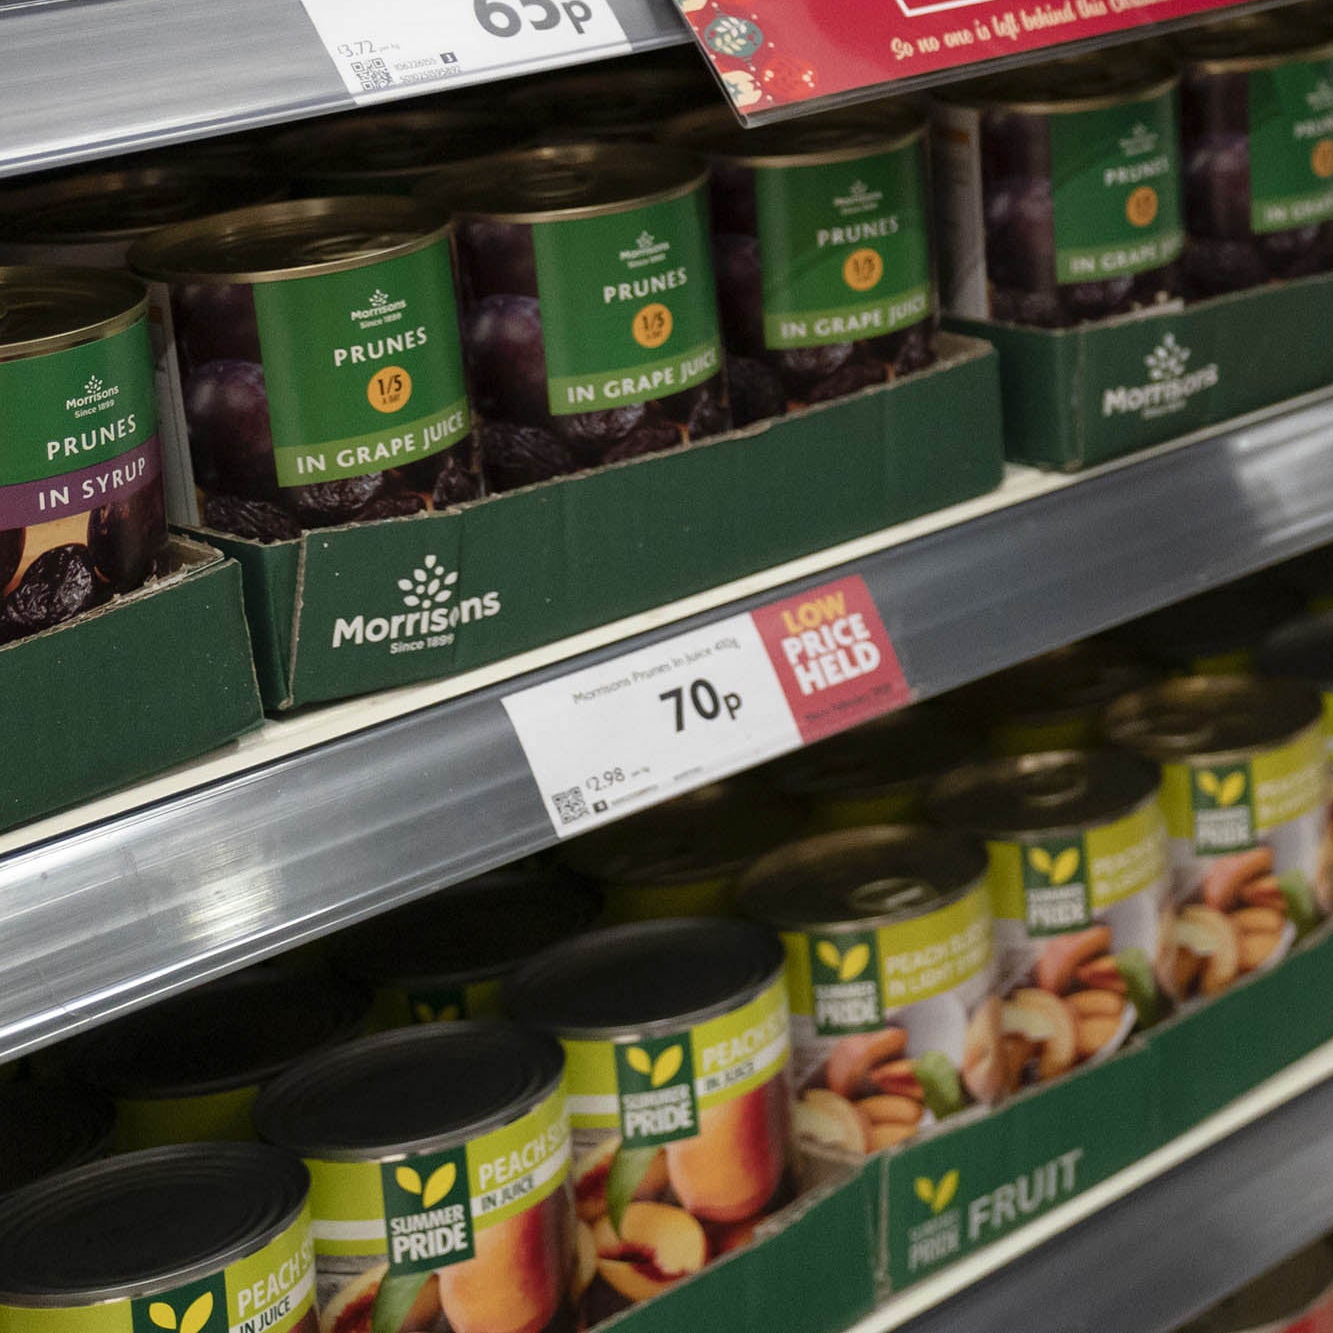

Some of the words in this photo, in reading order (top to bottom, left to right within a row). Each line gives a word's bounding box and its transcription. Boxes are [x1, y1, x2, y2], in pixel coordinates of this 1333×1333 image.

[890, 37, 913, 61] So
[916, 32, 941, 53] no
[943, 26, 973, 50] one
[977, 16, 991, 42] is
[990, 8, 1020, 41] left
[816, 216, 900, 248] PRUNES
[603, 266, 688, 304] PRUNES
[351, 299, 407, 321] Morrisons
[781, 321, 807, 340] IN
[814, 308, 881, 337] GRAPE
[333, 326, 428, 367] PRUNES
[65, 383, 120, 412] Morrisons
[377, 373, 403, 397] 1/5
[567, 384, 596, 404] IN
[603, 367, 675, 399] GRAPE
[1103, 363, 1220, 417] Morrisons
[74, 406, 97, 420] Since
[97, 398, 115, 413] 1899
[46, 413, 137, 460] PRUNES
[296, 454, 326, 475] IN
[336, 434, 416, 470] GRAPE
[422, 410, 466, 451] JUICE
[38, 485, 70, 511] IN
[81, 456, 147, 499] SYRUP
[780, 590, 847, 636] LOW
[390, 640, 425, 655] Since
[780, 612, 872, 667] PRICE
[572, 676, 632, 705] Morrisons
[632, 661, 672, 684] Prunes
[794, 640, 882, 697] HELD
[659, 678, 743, 733] 70p
[585, 766, 626, 794] £2.98
[624, 1100, 695, 1140] PRIDE
[478, 1133, 547, 1191] PEACH
[480, 1193, 497, 1213] IN
[968, 1146, 1084, 1241] FRUIT
[389, 1203, 466, 1237] SUMMER
[392, 1222, 469, 1264] PRIDE
[236, 1250, 301, 1319] PEACH
[258, 1295, 292, 1332] JUICE
